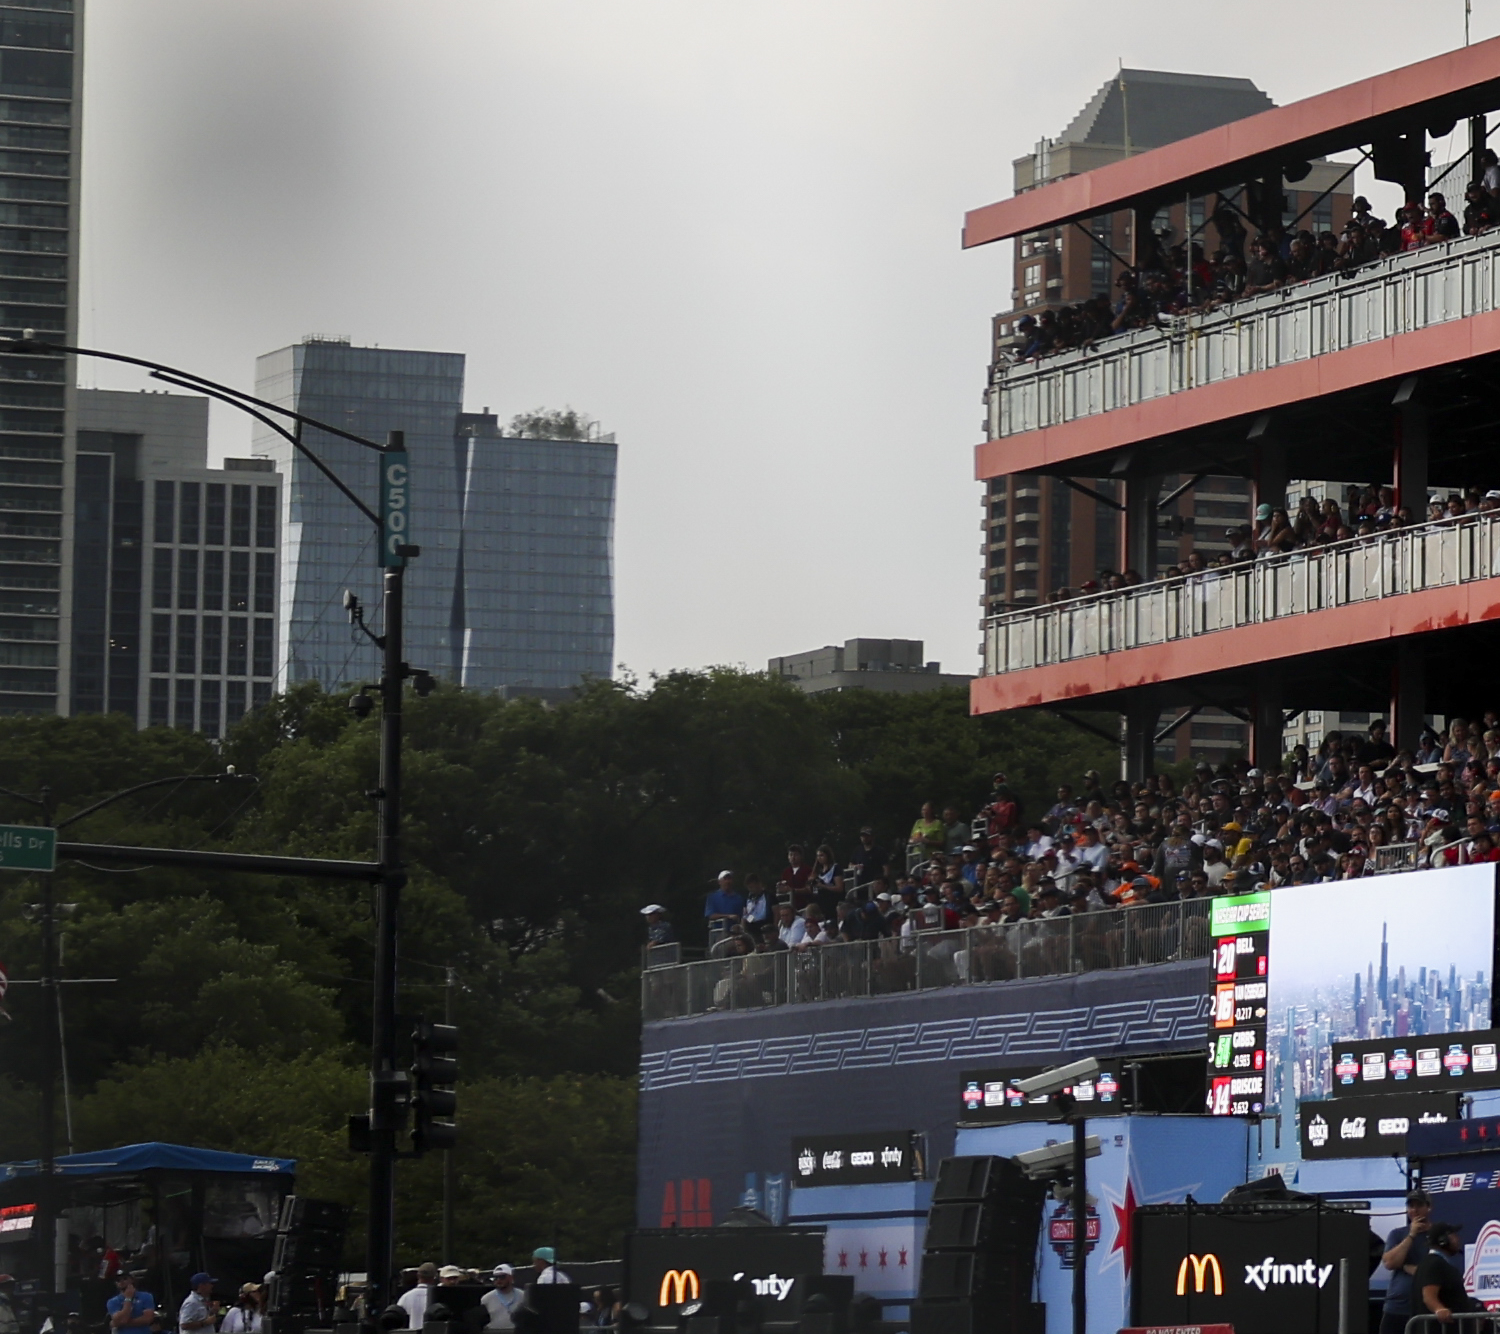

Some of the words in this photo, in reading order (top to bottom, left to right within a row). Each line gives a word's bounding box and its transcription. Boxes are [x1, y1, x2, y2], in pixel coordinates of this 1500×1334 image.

[0, 832, 22, 849] lls
[29, 837, 46, 850] Dr
[1213, 948, 1218, 969] 1
[1218, 942, 1236, 975] 20
[1236, 936, 1255, 954] BELL
[1210, 995, 1217, 1016] 2
[1216, 989, 1235, 1022] 16
[1208, 1042, 1215, 1063] 3
[1206, 1088, 1213, 1109] 4
[1213, 1082, 1231, 1115] 14
[1230, 1076, 1263, 1096] BRISCOE
[1378, 1117, 1410, 1135] GEICO
[850, 1151, 875, 1166] GEICO
[881, 1146, 903, 1168] xfinity
[1244, 1256, 1334, 1292] xfinity
